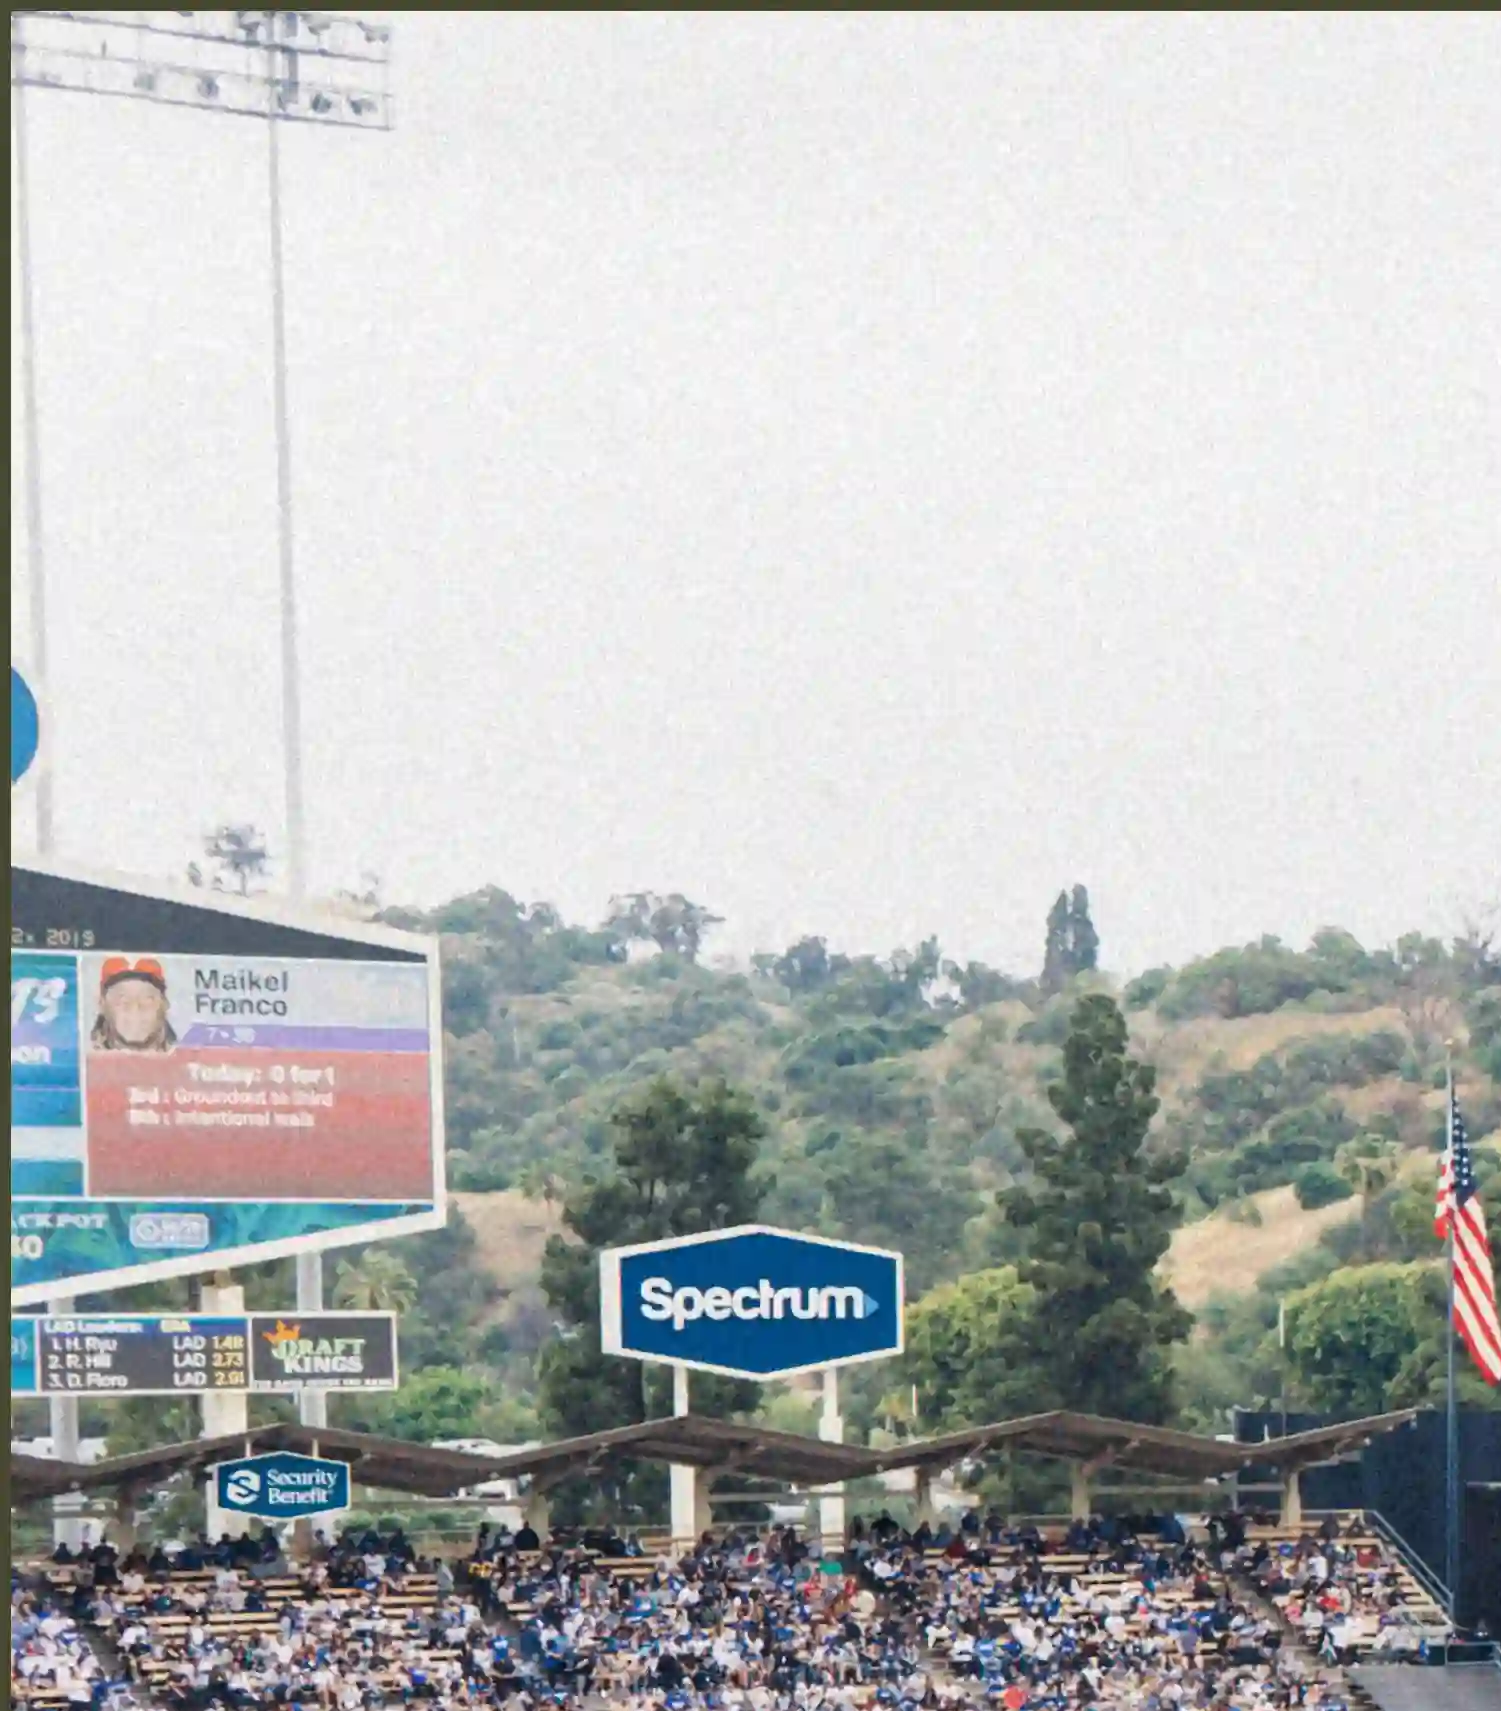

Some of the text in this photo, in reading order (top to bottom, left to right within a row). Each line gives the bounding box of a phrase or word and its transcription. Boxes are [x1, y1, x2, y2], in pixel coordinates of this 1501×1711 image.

[47, 928, 95, 947] 2019
[195, 970, 289, 992] Maikel
[196, 994, 288, 1016] Franco
[640, 1277, 864, 1330] Spectrum
[173, 1337, 206, 1350] LAD
[274, 1338, 366, 1358] DRAFT
[173, 1355, 206, 1368] LAD
[284, 1357, 364, 1373] KINGS
[173, 1373, 206, 1387] LAD
[267, 1468, 339, 1486] Security
[268, 1488, 328, 1504] Benefit
